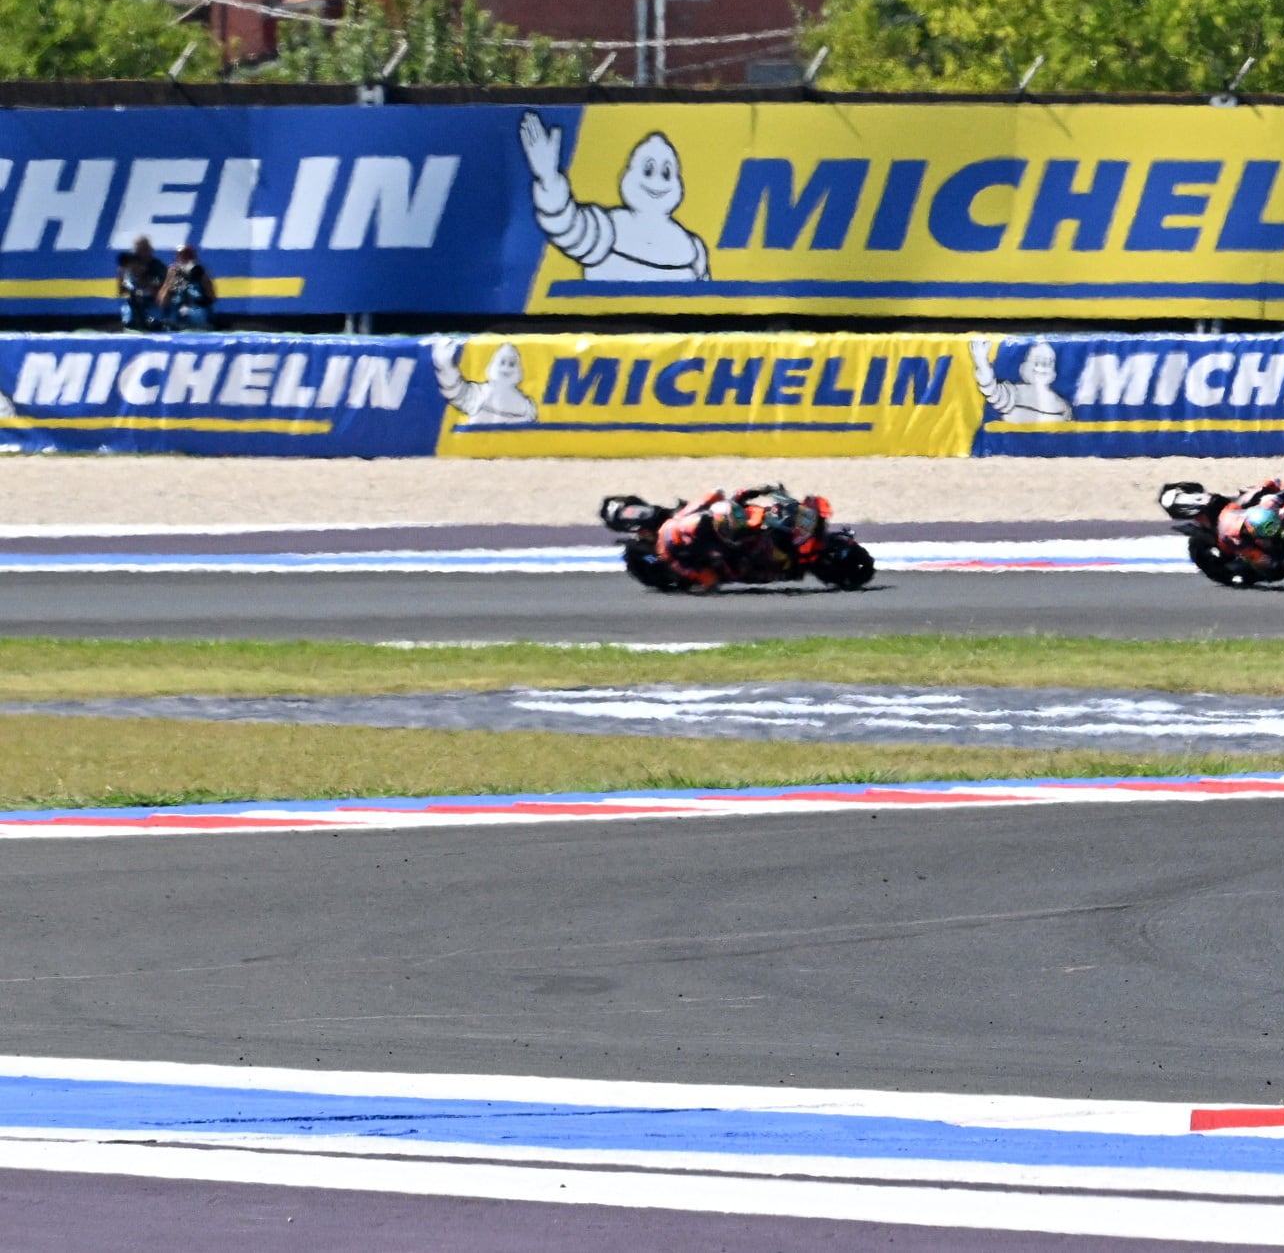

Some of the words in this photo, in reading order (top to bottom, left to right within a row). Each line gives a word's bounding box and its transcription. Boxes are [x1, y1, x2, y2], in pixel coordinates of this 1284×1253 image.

[0, 156, 460, 251] HELIN
[12, 351, 416, 410] MICHELIN
[543, 357, 953, 408] MICHELIN
